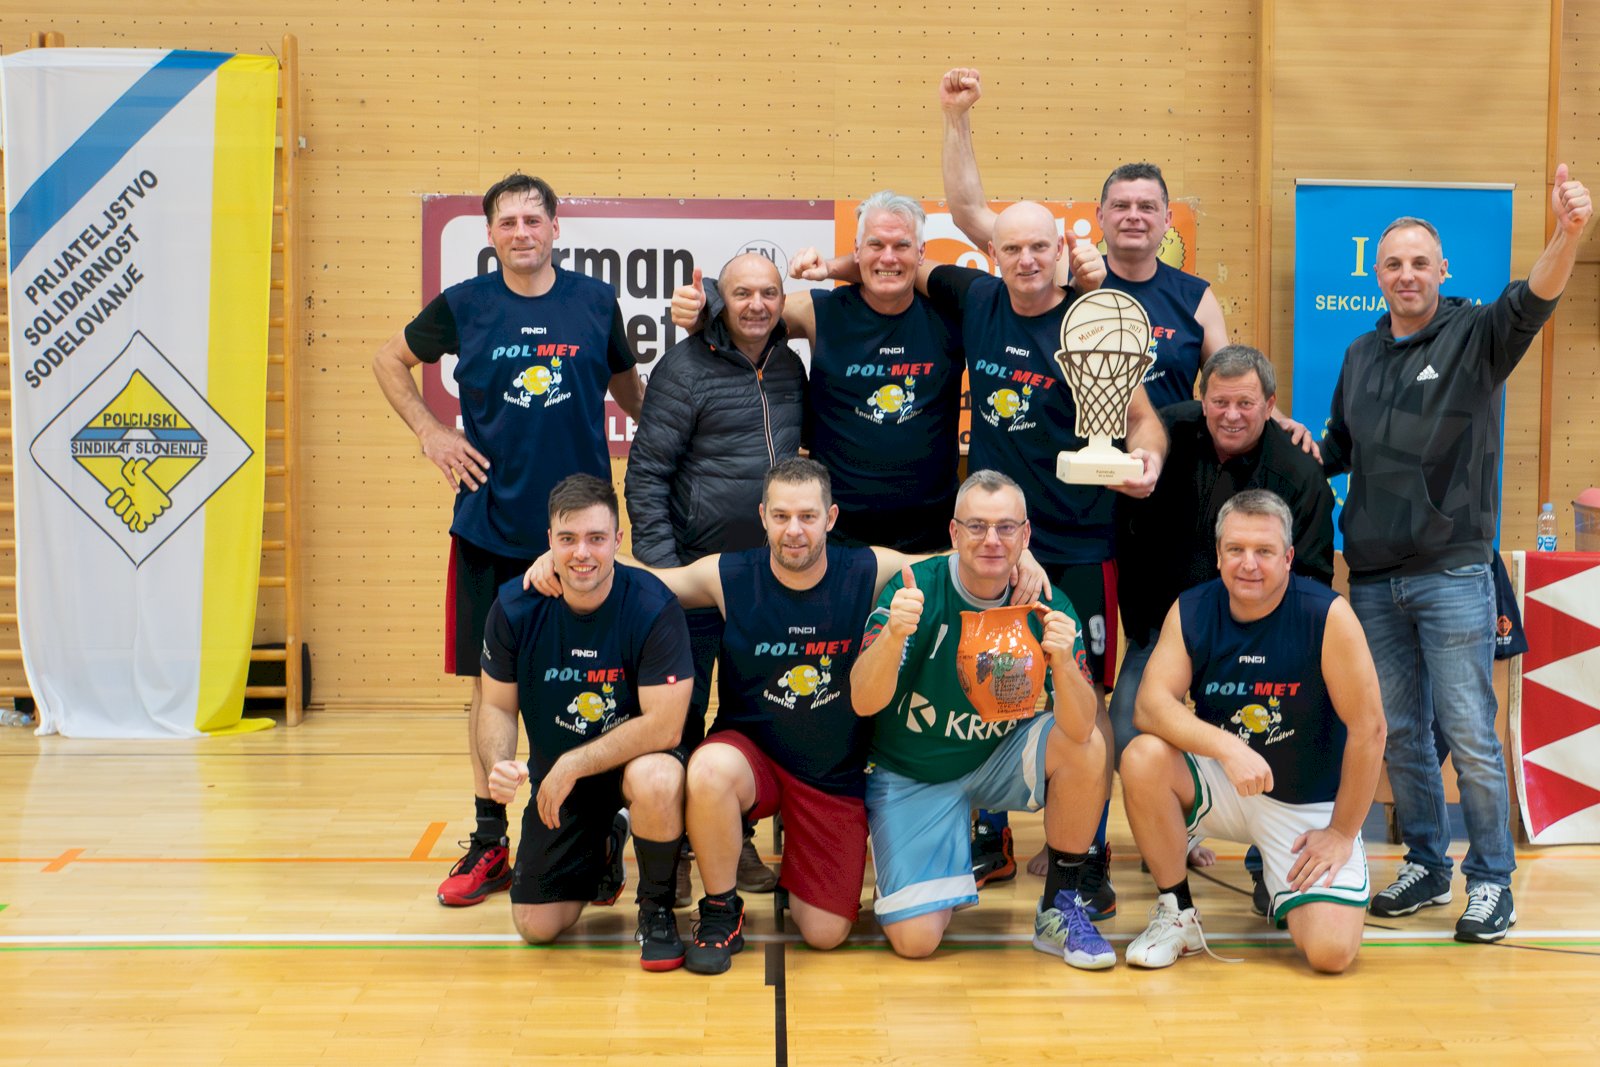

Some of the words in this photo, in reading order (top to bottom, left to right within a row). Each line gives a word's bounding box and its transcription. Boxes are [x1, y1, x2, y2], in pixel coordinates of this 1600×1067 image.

[24, 169, 158, 305] PRIJATELJSTVO
[24, 223, 140, 346] SOLIDARNOST
[24, 263, 144, 389] SODELOVANJE
[1315, 295, 1388, 311] SEKCIJA
[71, 441, 130, 455] SINDIKAT
[136, 442, 208, 456] SLOVENIJE
